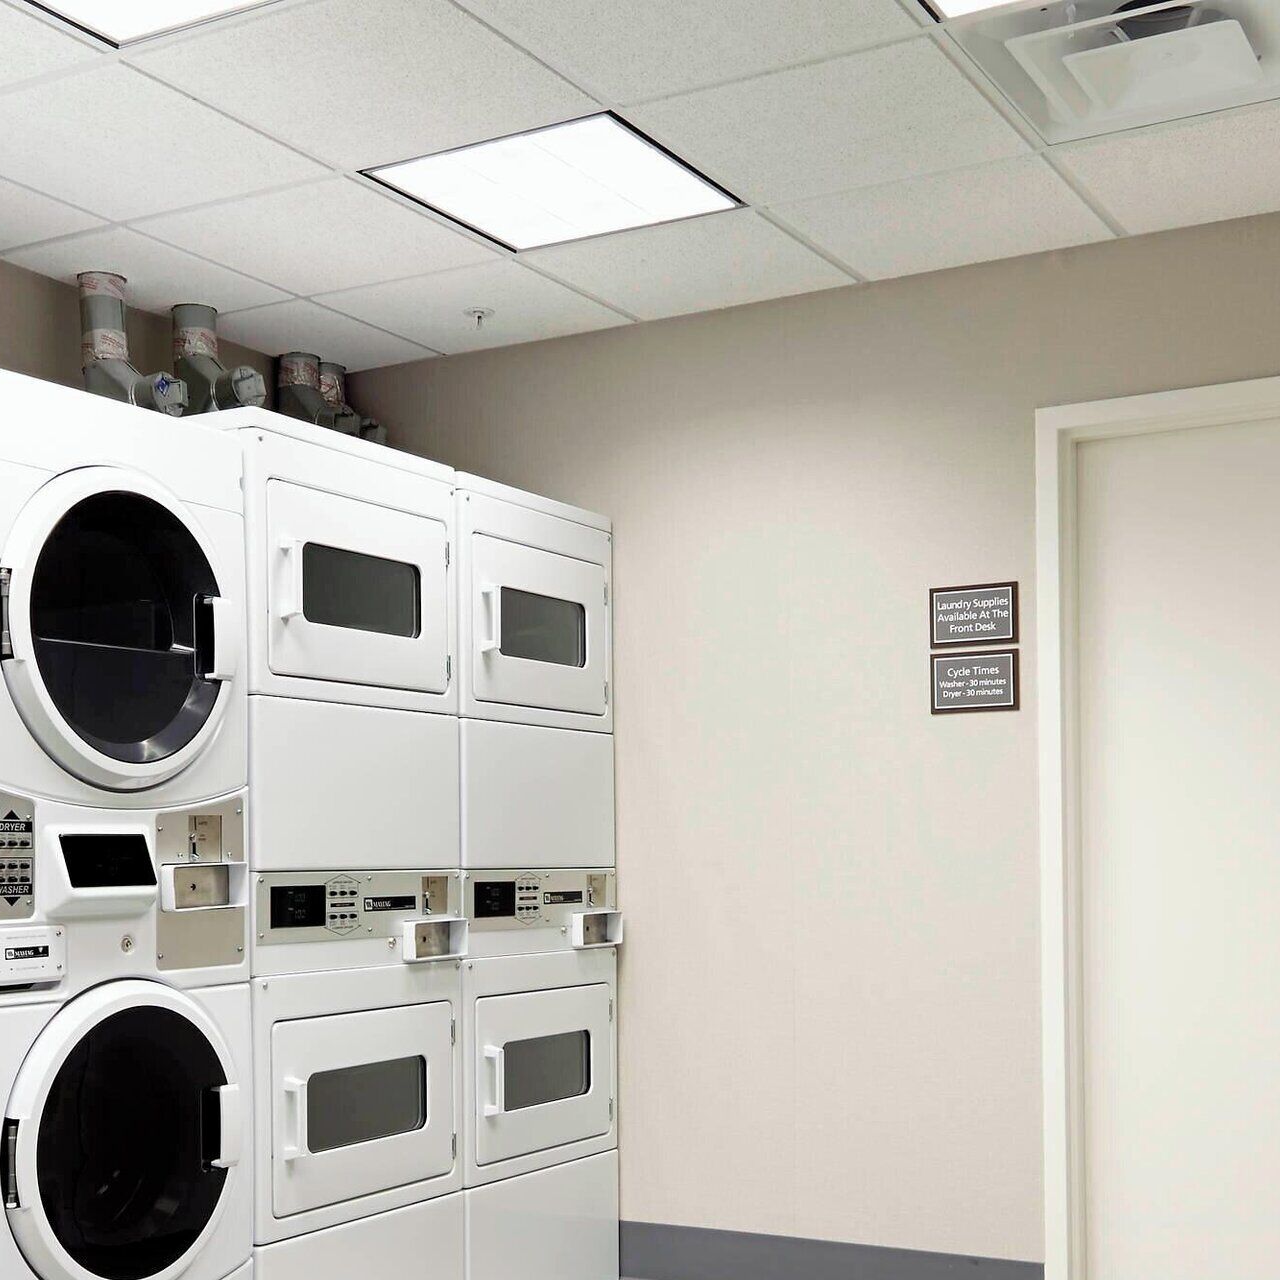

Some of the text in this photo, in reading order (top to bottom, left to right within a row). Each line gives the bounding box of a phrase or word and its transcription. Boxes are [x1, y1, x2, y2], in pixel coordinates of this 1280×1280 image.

[937, 596, 1009, 610] Laundry Supplies
[937, 608, 1009, 622] Available At The
[949, 621, 997, 633] Front Desk
[947, 666, 1000, 679] Cycle Times
[939, 680, 966, 689] Washer
[969, 679, 979, 687] 30
[978, 678, 1007, 687] minutes
[942, 690, 962, 700] Dryer
[966, 688, 975, 697] 30
[975, 688, 1004, 696] minutes
